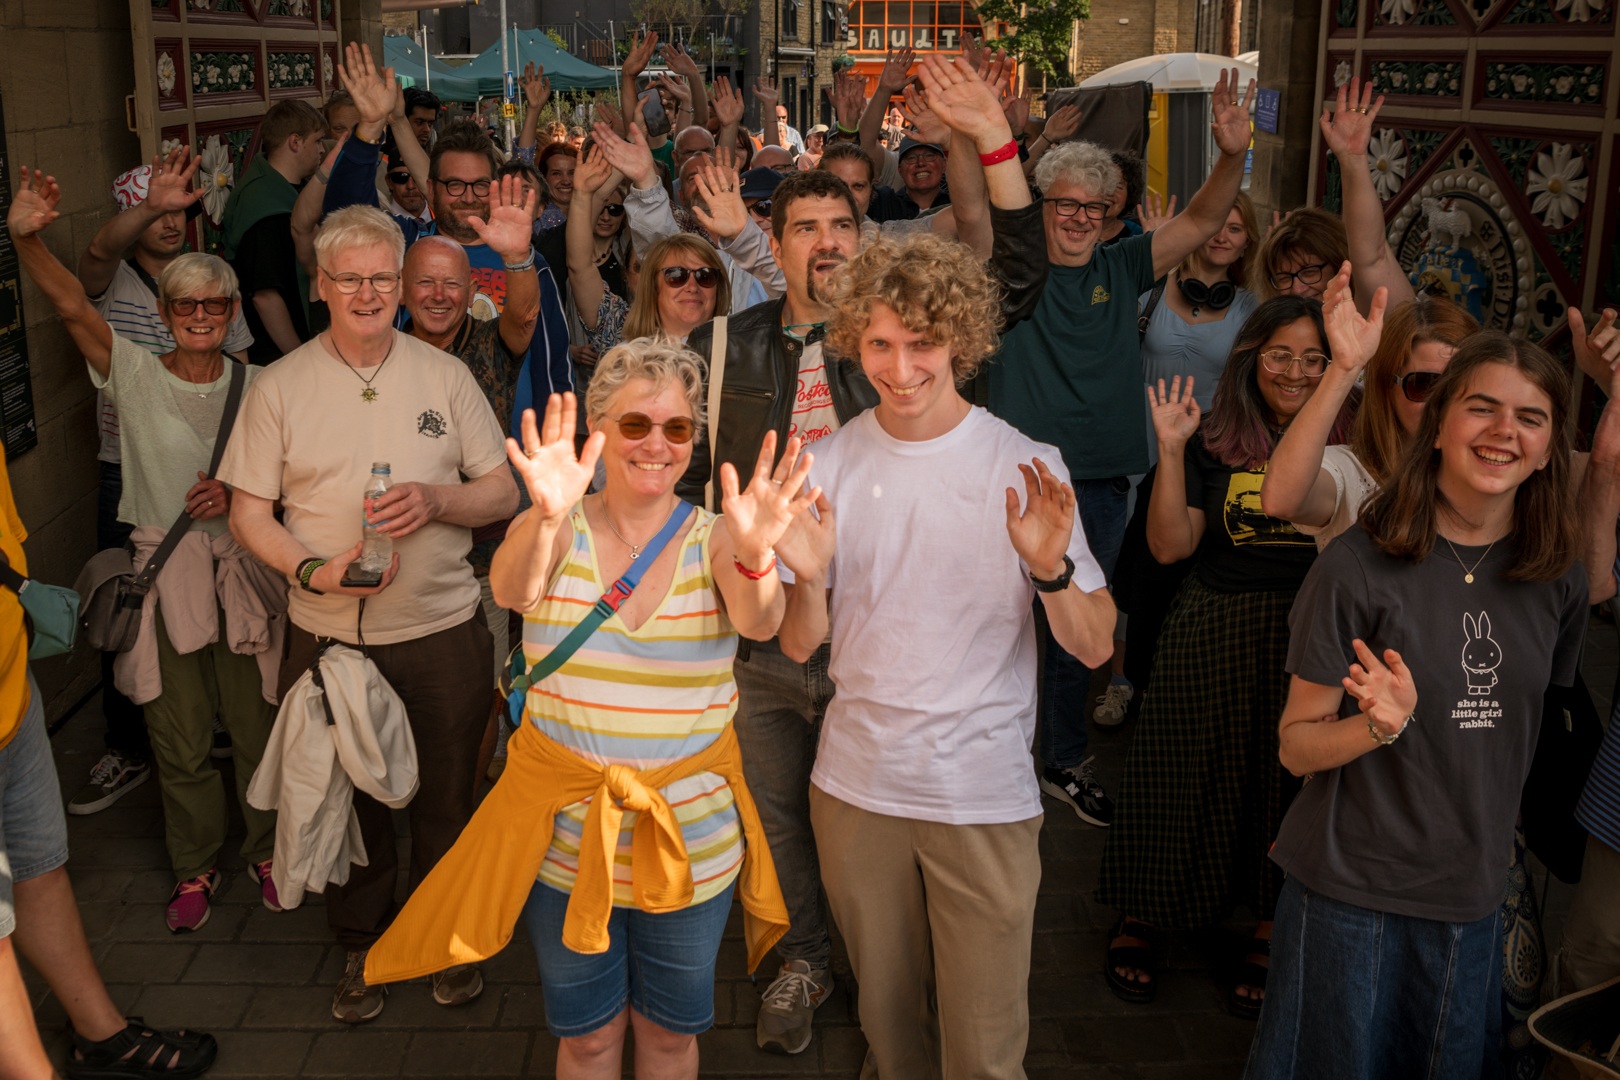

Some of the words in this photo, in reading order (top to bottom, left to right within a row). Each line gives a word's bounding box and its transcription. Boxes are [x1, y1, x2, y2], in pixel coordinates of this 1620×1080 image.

[1457, 699, 1478, 708] she
[1479, 699, 1490, 707] is
[1491, 700, 1500, 708] a
[1451, 709, 1479, 719] little
[1479, 708, 1503, 720] girl
[1459, 719, 1495, 729] rabbit.
